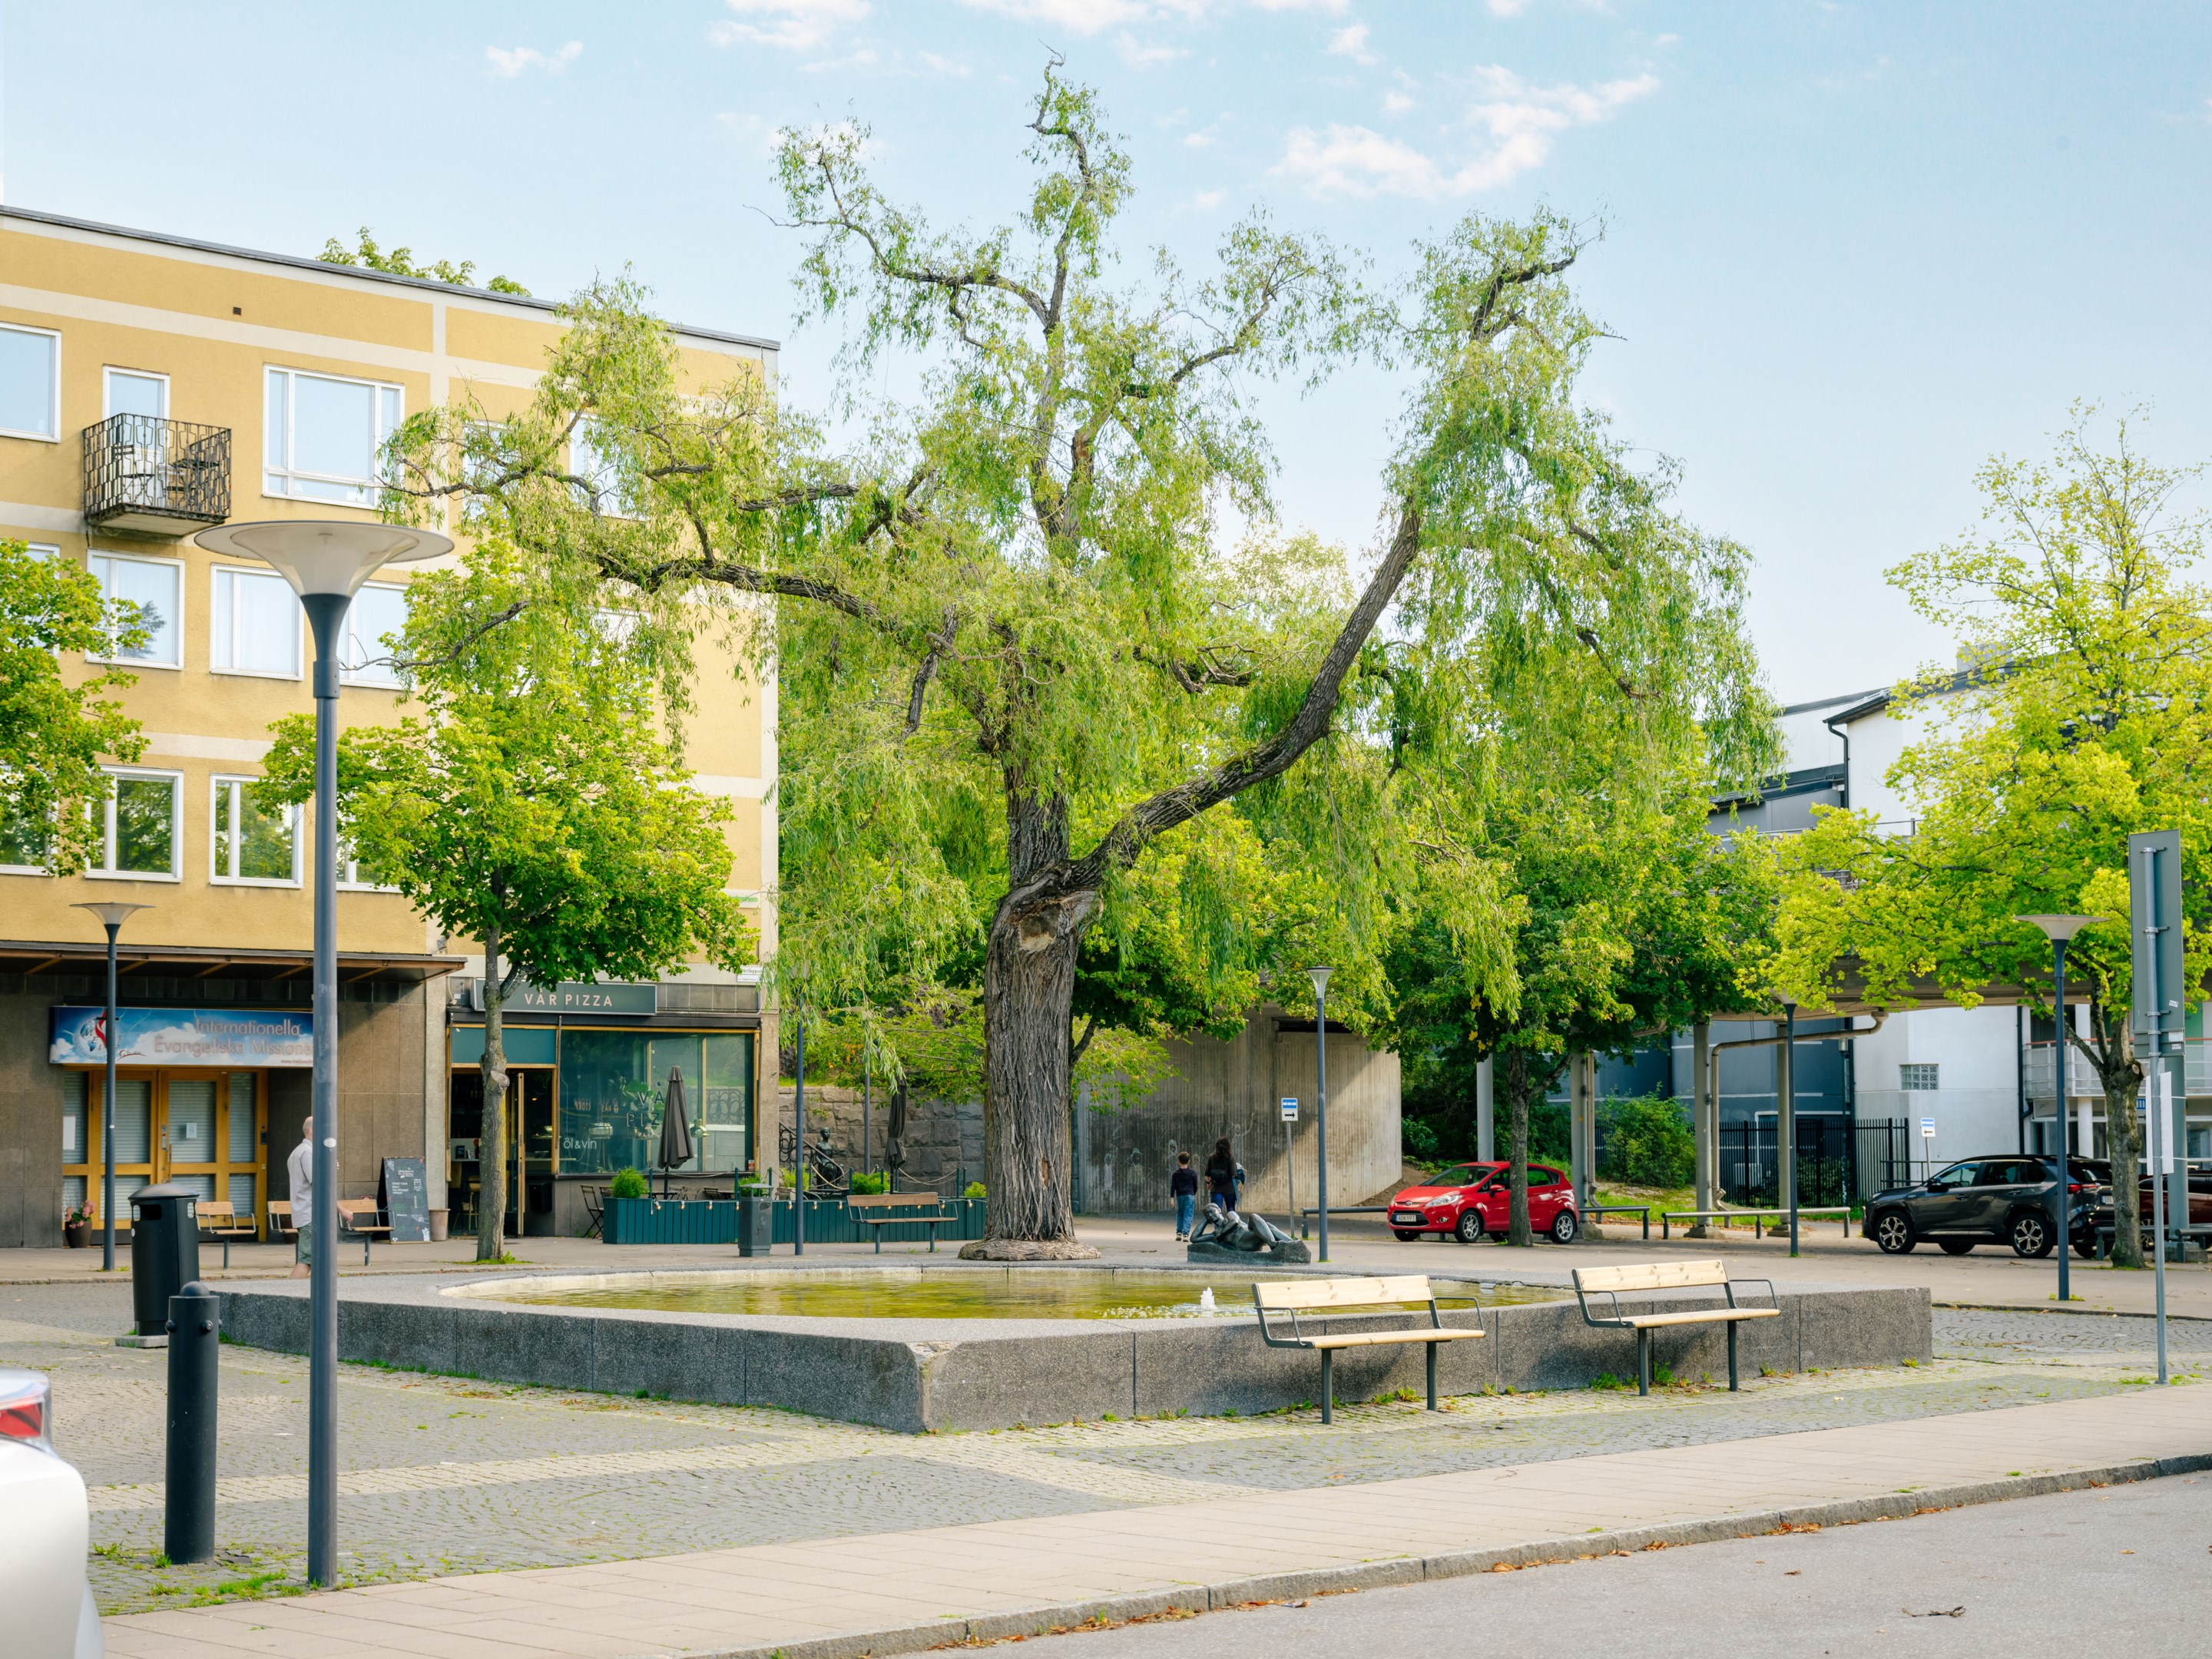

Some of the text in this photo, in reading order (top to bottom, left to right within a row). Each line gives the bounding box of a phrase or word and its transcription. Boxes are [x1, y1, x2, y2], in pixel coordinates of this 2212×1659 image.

[525, 988, 613, 1007] VÅR PIZZA
[195, 1018, 300, 1036] Internationella
[154, 1036, 245, 1057] Evangeliska
[250, 1039, 313, 1056] Missione
[637, 1081, 664, 1105] VÅ
[626, 1112, 661, 1127] PIZ
